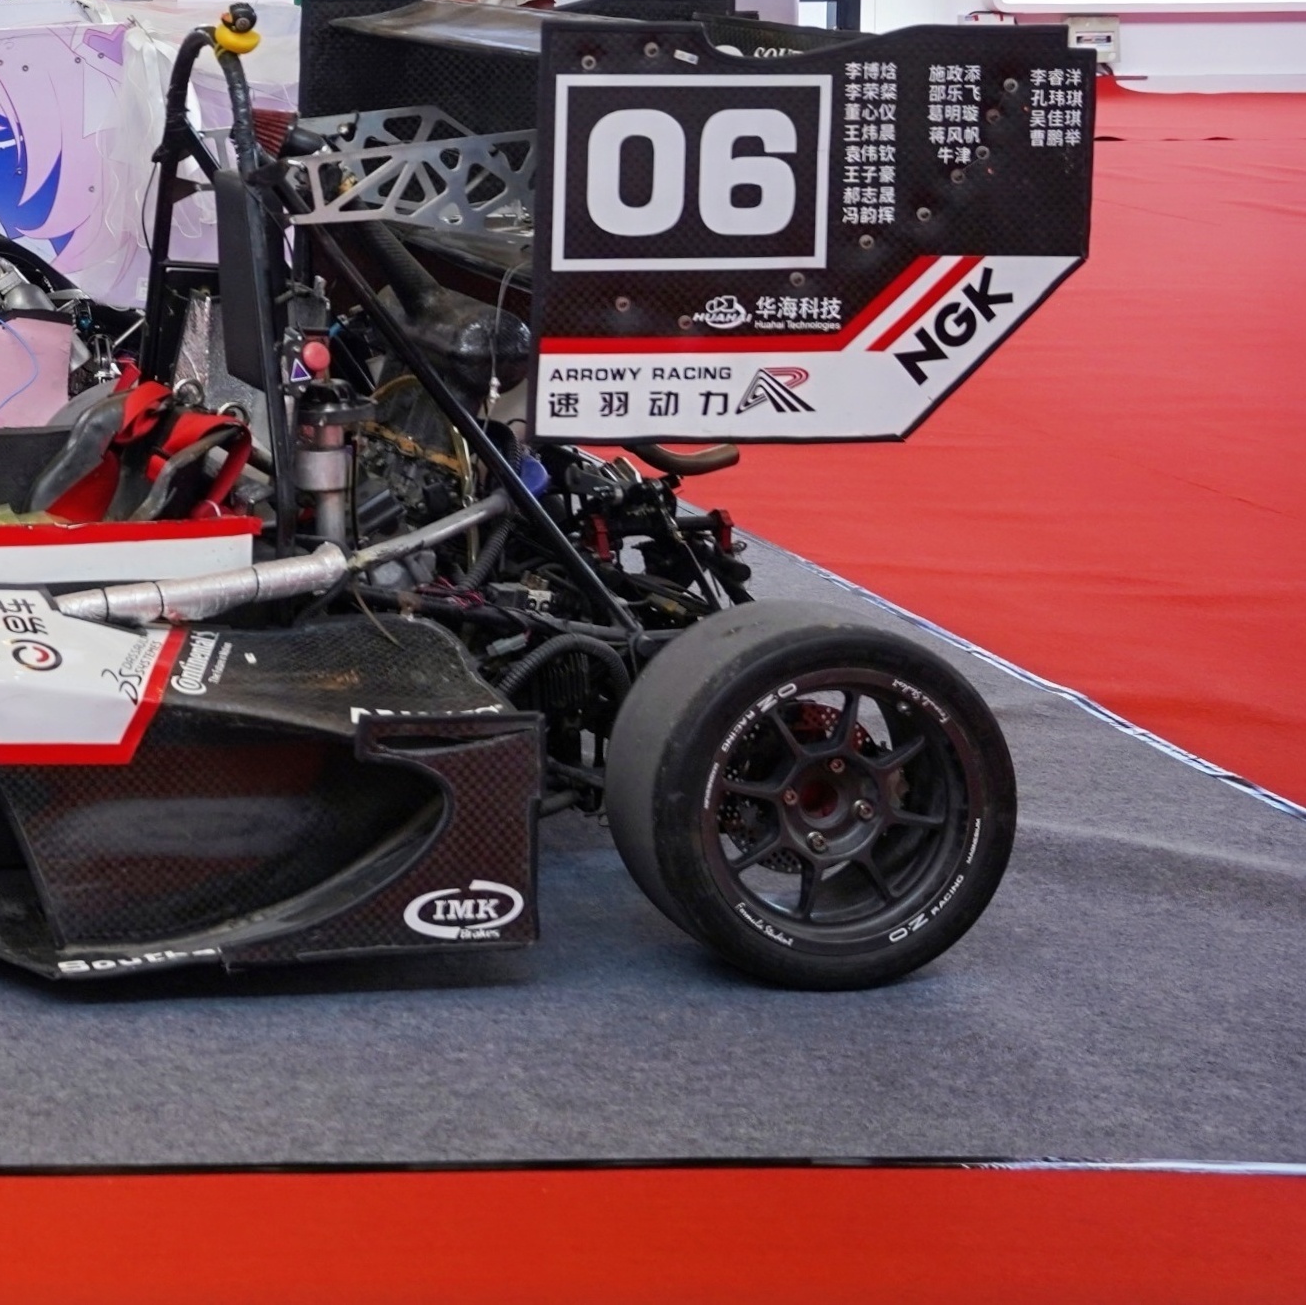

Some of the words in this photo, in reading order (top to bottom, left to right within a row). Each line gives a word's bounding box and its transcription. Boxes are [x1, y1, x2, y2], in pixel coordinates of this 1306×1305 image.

[1029, 68, 1082, 86] 李睿洋
[928, 85, 981, 102] 邵乐飞
[1030, 89, 1083, 108] 孔玮琪
[843, 103, 896, 121] 董心仪
[1029, 110, 1082, 128] 吴佳琪
[928, 127, 981, 144] 蒋风帆
[1029, 129, 1082, 147] 曹鹏举
[937, 147, 971, 164] 牛津
[587, 108, 798, 237] 06
[843, 165, 896, 183] 王子豪
[755, 296, 842, 320] 华海科技
[755, 319, 785, 329] Huahai
[787, 319, 842, 331] Technologies
[895, 267, 1014, 385] NGK
[550, 367, 642, 382] ARROWY
[652, 367, 732, 380] RACING
[549, 390, 729, 418] 速羽动力
[722, 710, 755, 754] RACING
[930, 874, 965, 917] RACING
[433, 898, 500, 921] IMK
